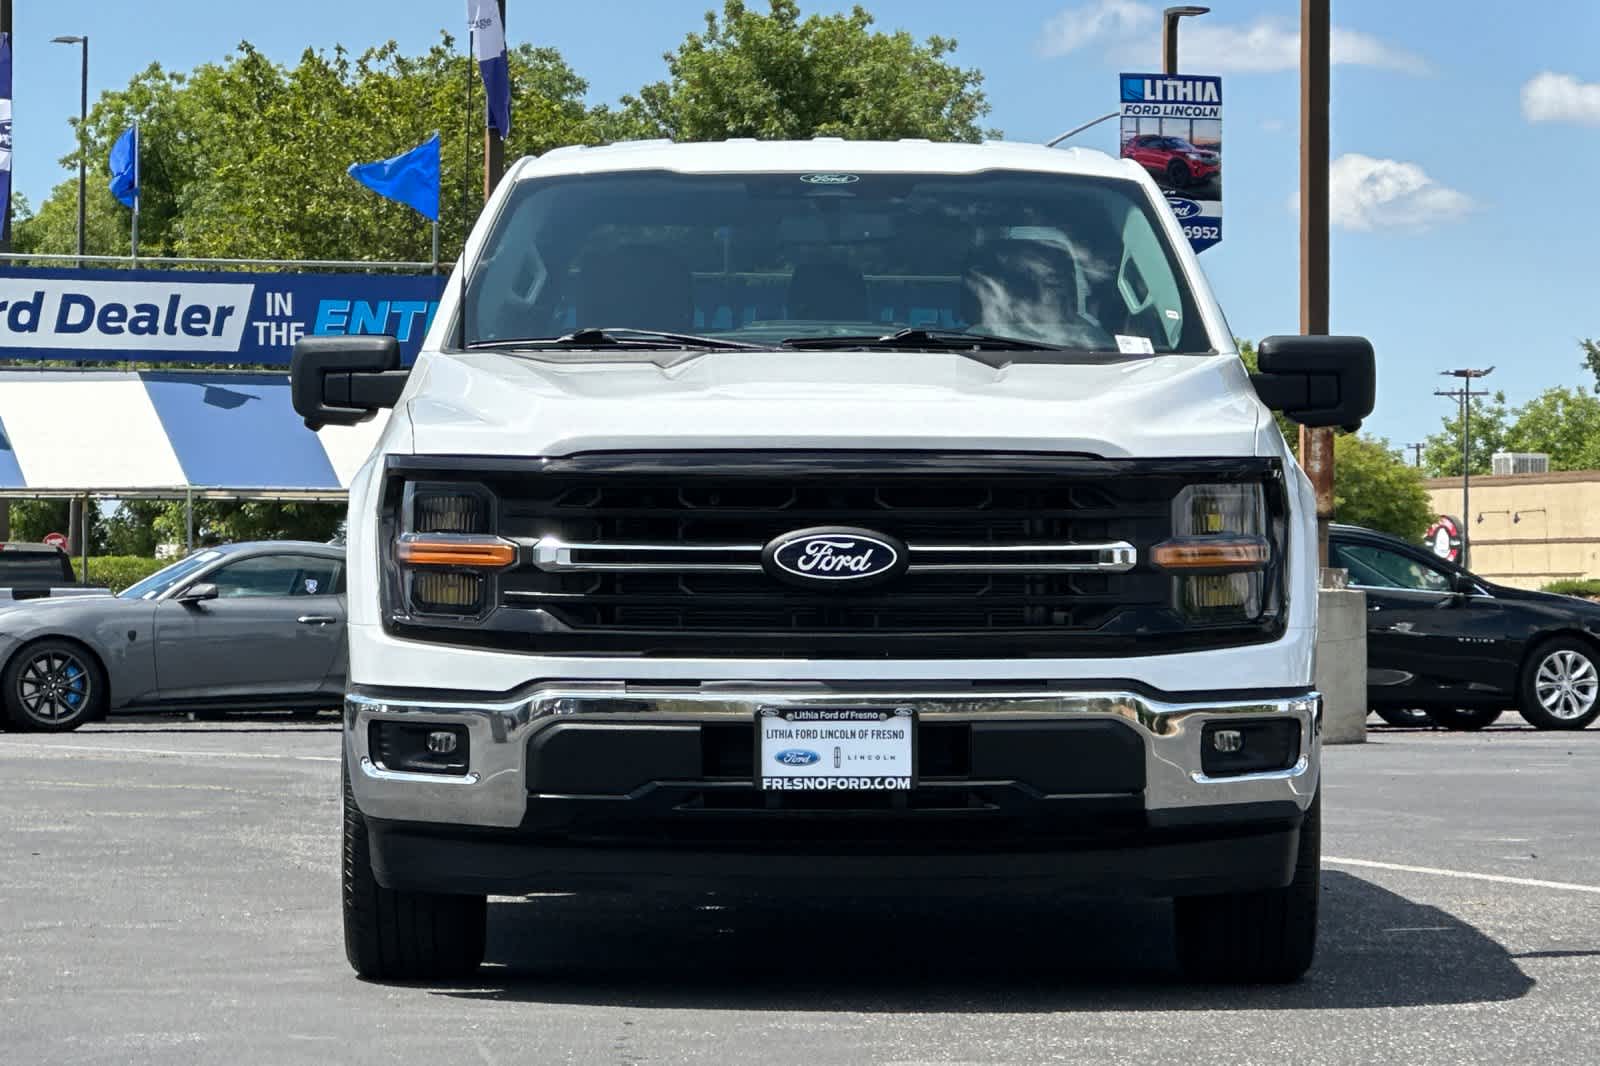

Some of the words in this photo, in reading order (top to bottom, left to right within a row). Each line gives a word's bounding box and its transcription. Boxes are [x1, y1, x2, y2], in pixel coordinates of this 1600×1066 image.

[1144, 79, 1219, 103] LITHIA
[1124, 104, 1161, 115] FORD
[1163, 106, 1219, 117] LINCOLN
[266, 292, 293, 317] IN
[54, 292, 235, 337] Dealer
[797, 540, 874, 571] Ford
[794, 711, 819, 720] Lithia
[820, 711, 839, 720] Ford
[840, 711, 849, 720] of
[850, 711, 879, 720] Fresno
[766, 729, 794, 740] LITHIA
[795, 729, 818, 740] FORD
[820, 729, 856, 740] LINCOLN
[858, 729, 868, 740] OF
[871, 729, 905, 740] FRESNO
[783, 752, 811, 764] Ford
[762, 777, 911, 790] FRESNOFORD.COM
